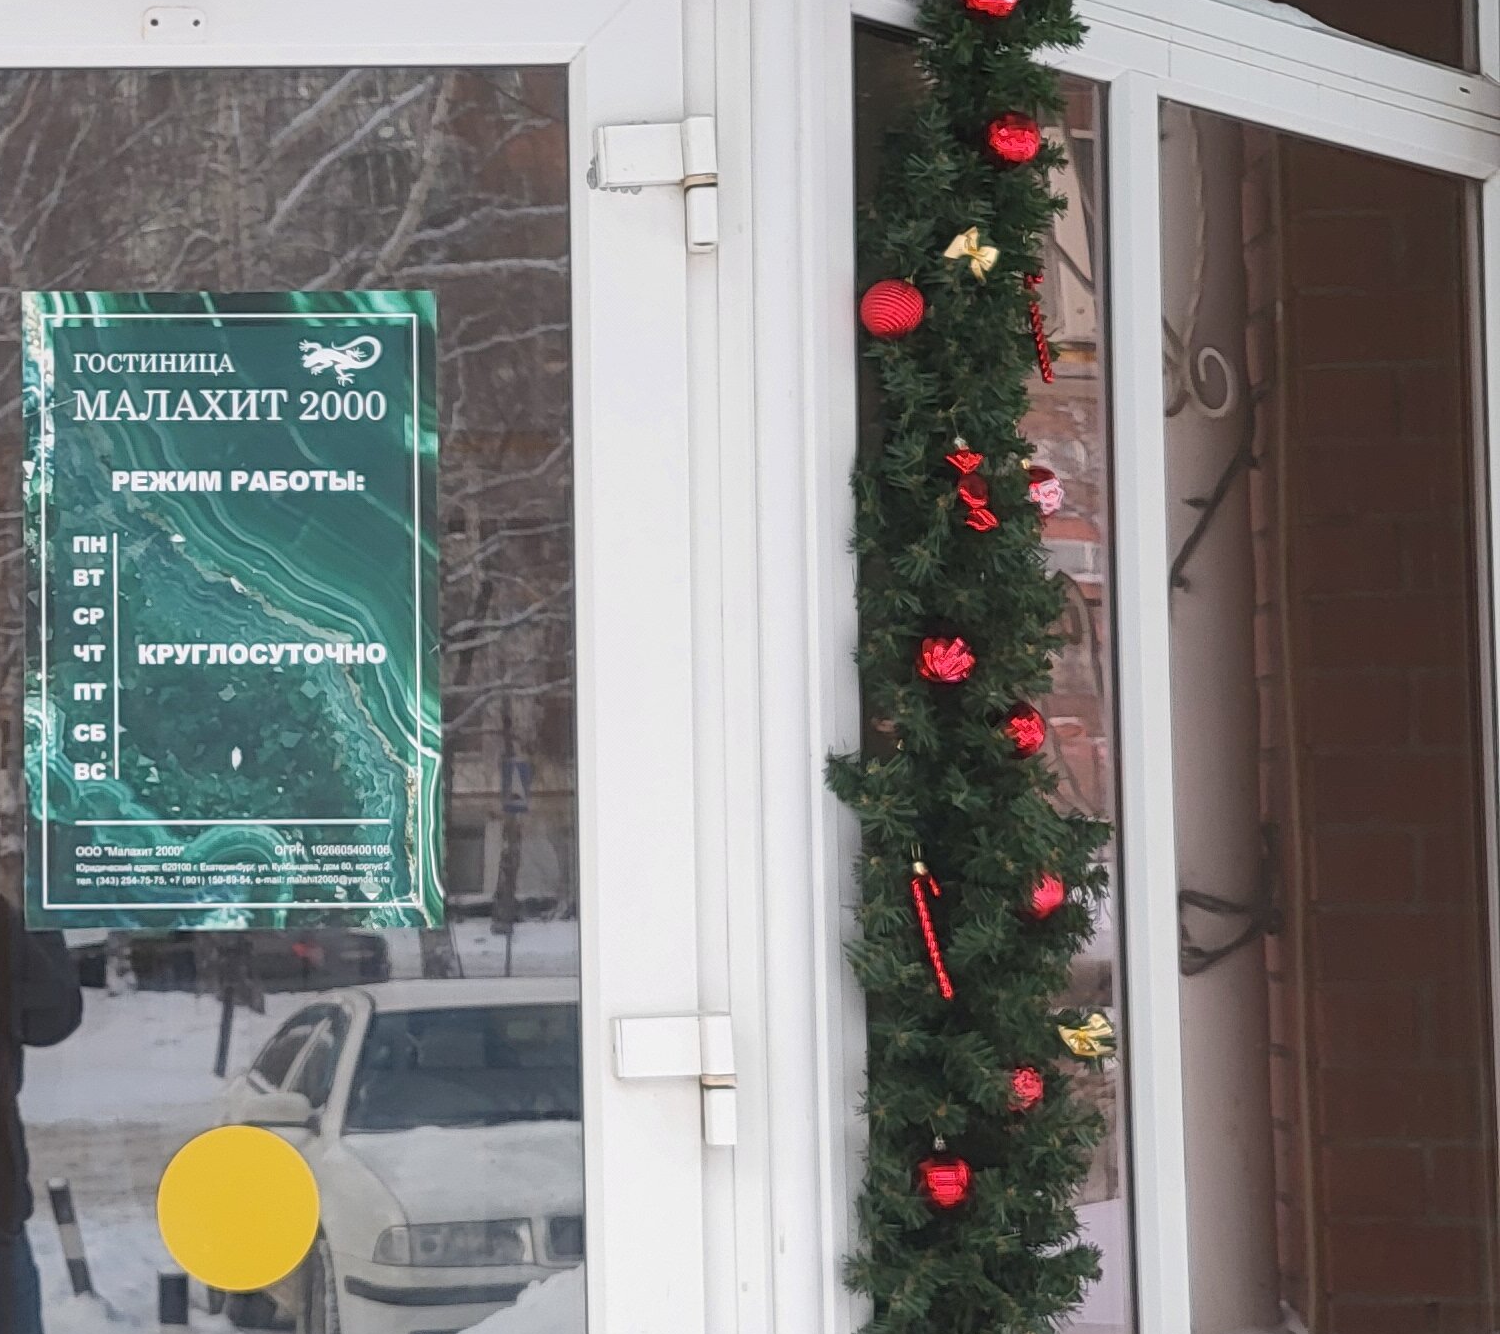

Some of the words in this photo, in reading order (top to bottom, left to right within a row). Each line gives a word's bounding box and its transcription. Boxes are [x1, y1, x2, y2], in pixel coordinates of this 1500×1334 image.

[72, 353, 236, 376] ГОСТИНИЦА
[72, 389, 288, 421] МАЛАХИТ
[299, 390, 387, 421] 2000
[112, 470, 222, 492] РЕЖИМ
[231, 470, 366, 492] РАБОТЫ:
[73, 536, 107, 553] ПН
[73, 569, 105, 586] ВТ
[73, 607, 105, 625] СР
[73, 644, 106, 662] ЧТ
[138, 643, 387, 665] КРУГЛОСУТОЧНО
[73, 683, 107, 701] ПТ
[73, 723, 107, 742] СБ
[74, 762, 107, 781] ВС
[75, 845, 102, 857] ООО
